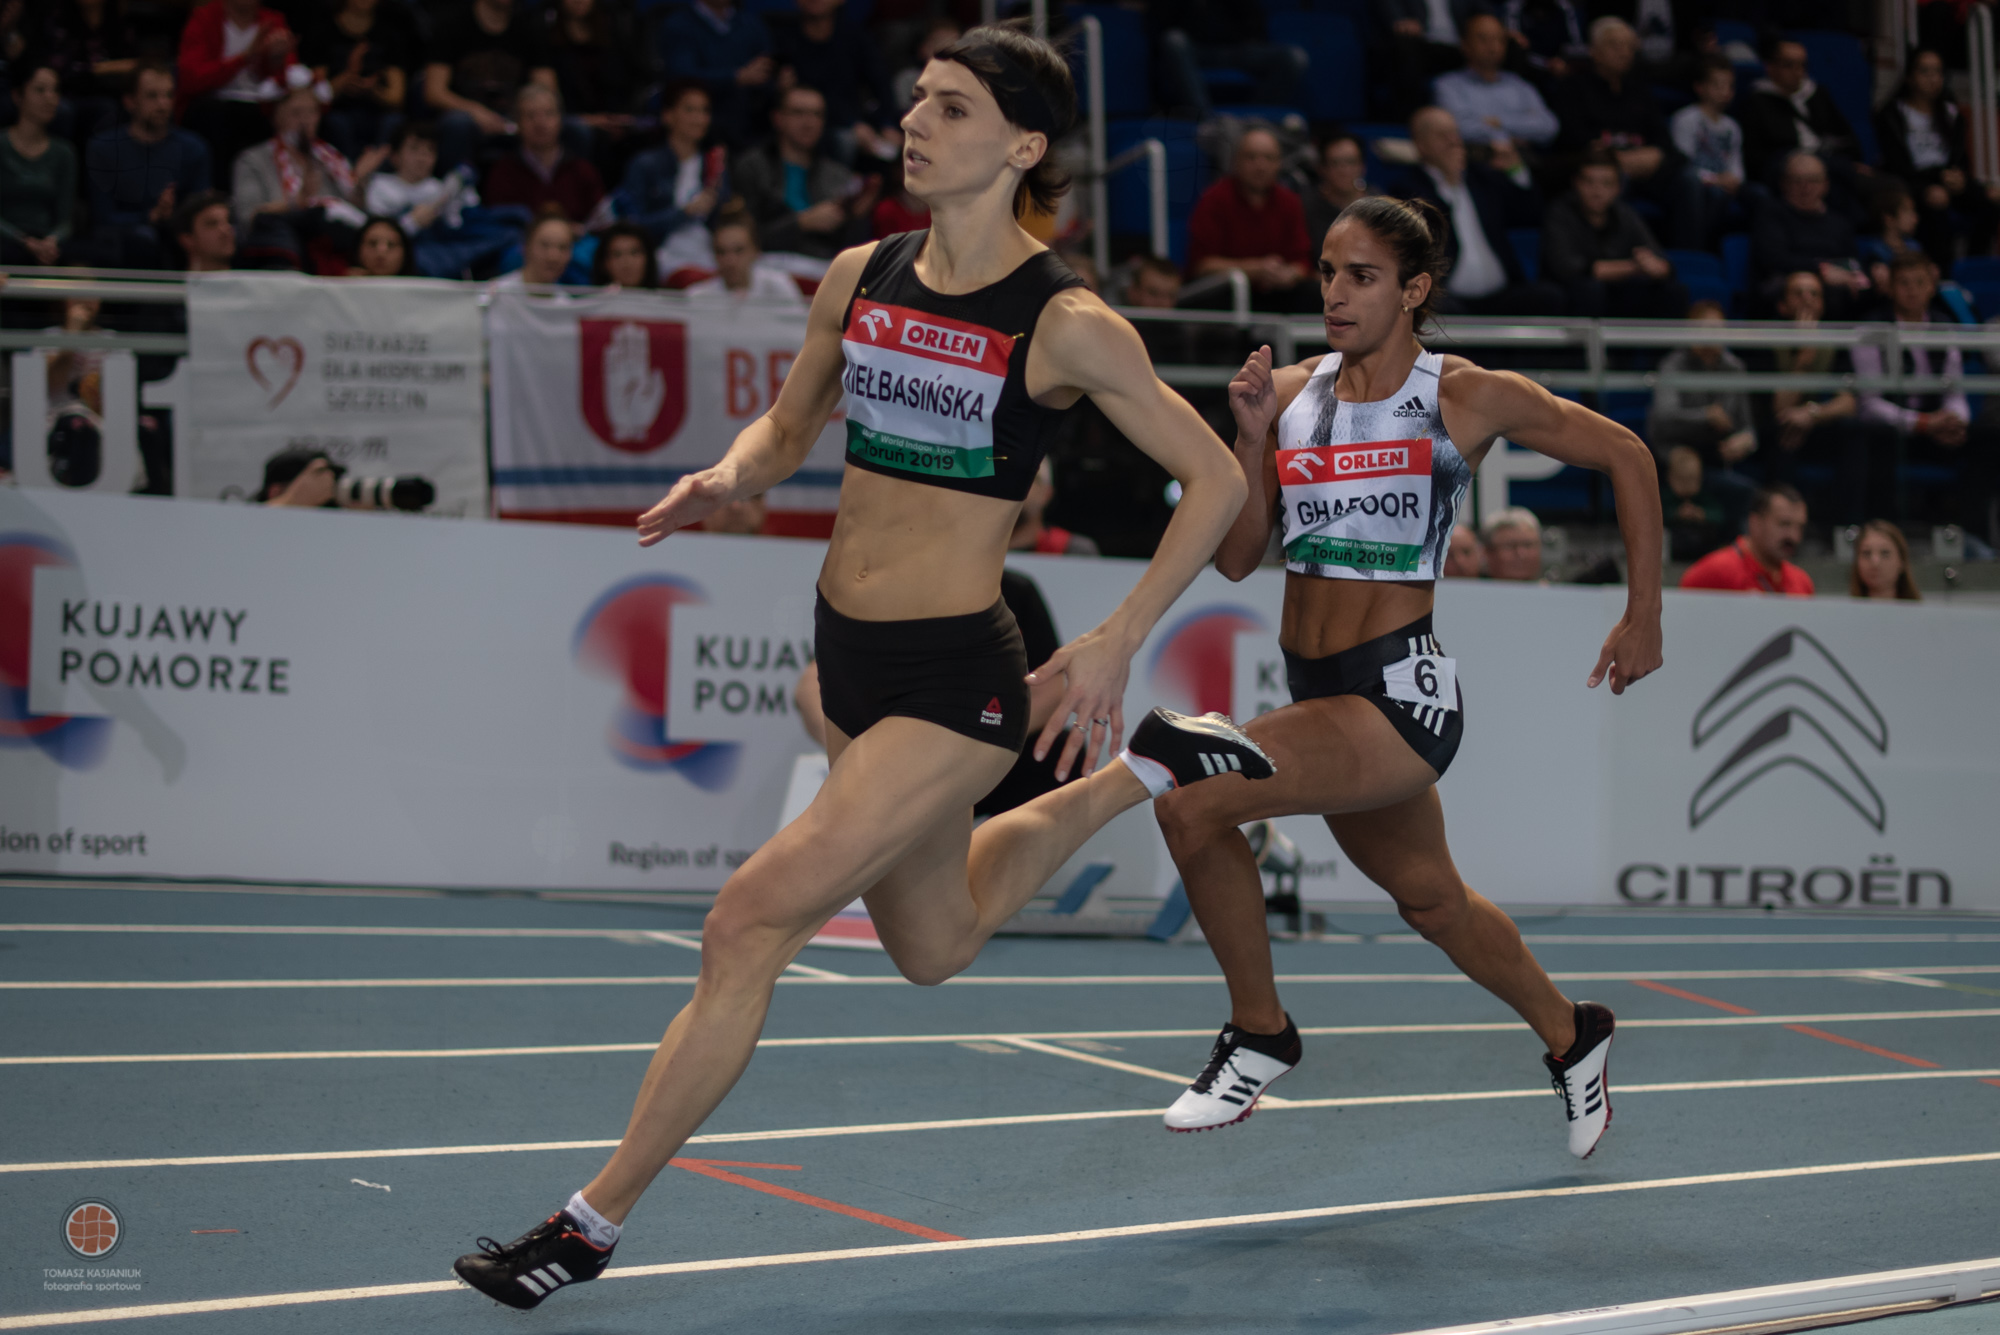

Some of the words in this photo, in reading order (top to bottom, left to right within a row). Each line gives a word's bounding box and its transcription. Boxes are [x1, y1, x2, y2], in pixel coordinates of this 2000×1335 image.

[907, 325, 980, 357] ORLEN
[1393, 410, 1431, 418] adidas
[863, 438, 905, 463] Toruń
[909, 451, 954, 470] 2019
[881, 434, 904, 447] World
[905, 440, 933, 452] Indoor
[936, 446, 956, 454] Tour
[1338, 451, 1404, 471] ORLEN
[1297, 493, 1420, 525] GHAFOOR
[1308, 536, 1326, 544] IAAF
[1330, 539, 1352, 548] World
[1354, 541, 1378, 550] Indoor
[1381, 544, 1398, 552] Tour
[1311, 545, 1352, 562] Toruń
[1357, 551, 1396, 566] 2019
[61, 600, 247, 644] KUJAWY
[694, 635, 815, 670] KUJA
[60, 649, 290, 694] POMORZE
[0, 825, 40, 853] ion
[48, 827, 74, 853] of
[81, 831, 147, 859] sport
[609, 841, 689, 870] Region
[694, 843, 718, 868] of
